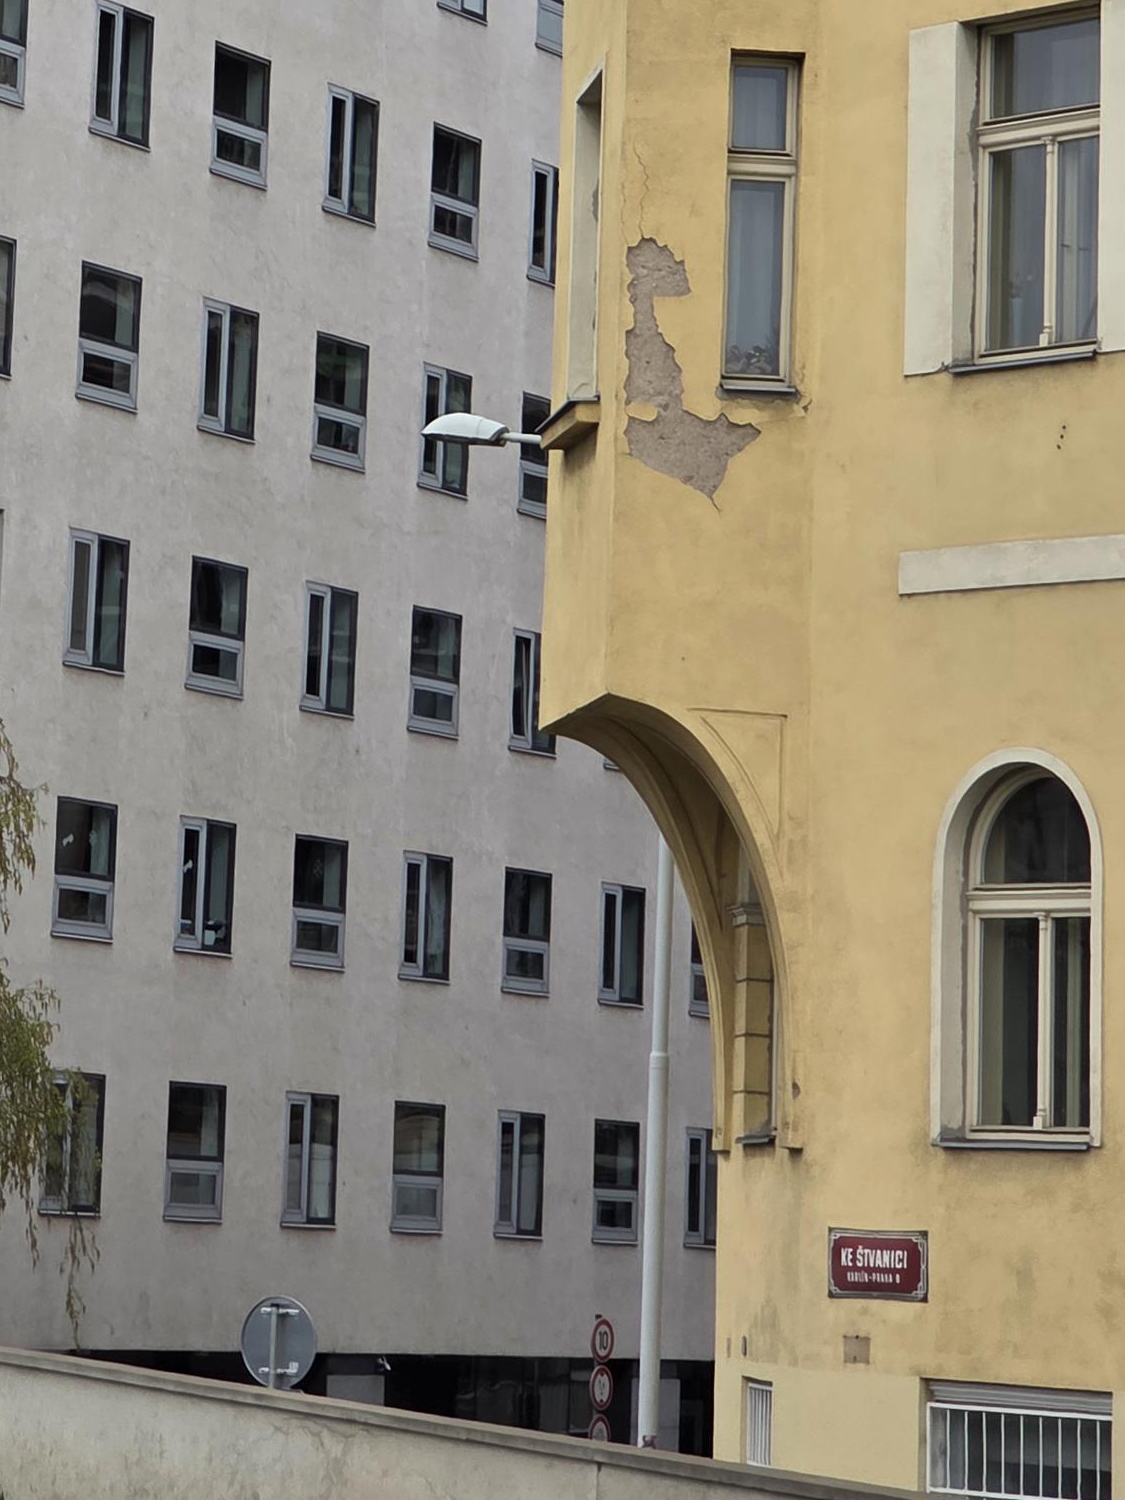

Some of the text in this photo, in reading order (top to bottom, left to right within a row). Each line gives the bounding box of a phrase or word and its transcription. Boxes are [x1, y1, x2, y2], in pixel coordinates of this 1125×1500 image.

[841, 1245, 907, 1268] KE ŠTVANICI
[598, 1330, 609, 1350] 10
